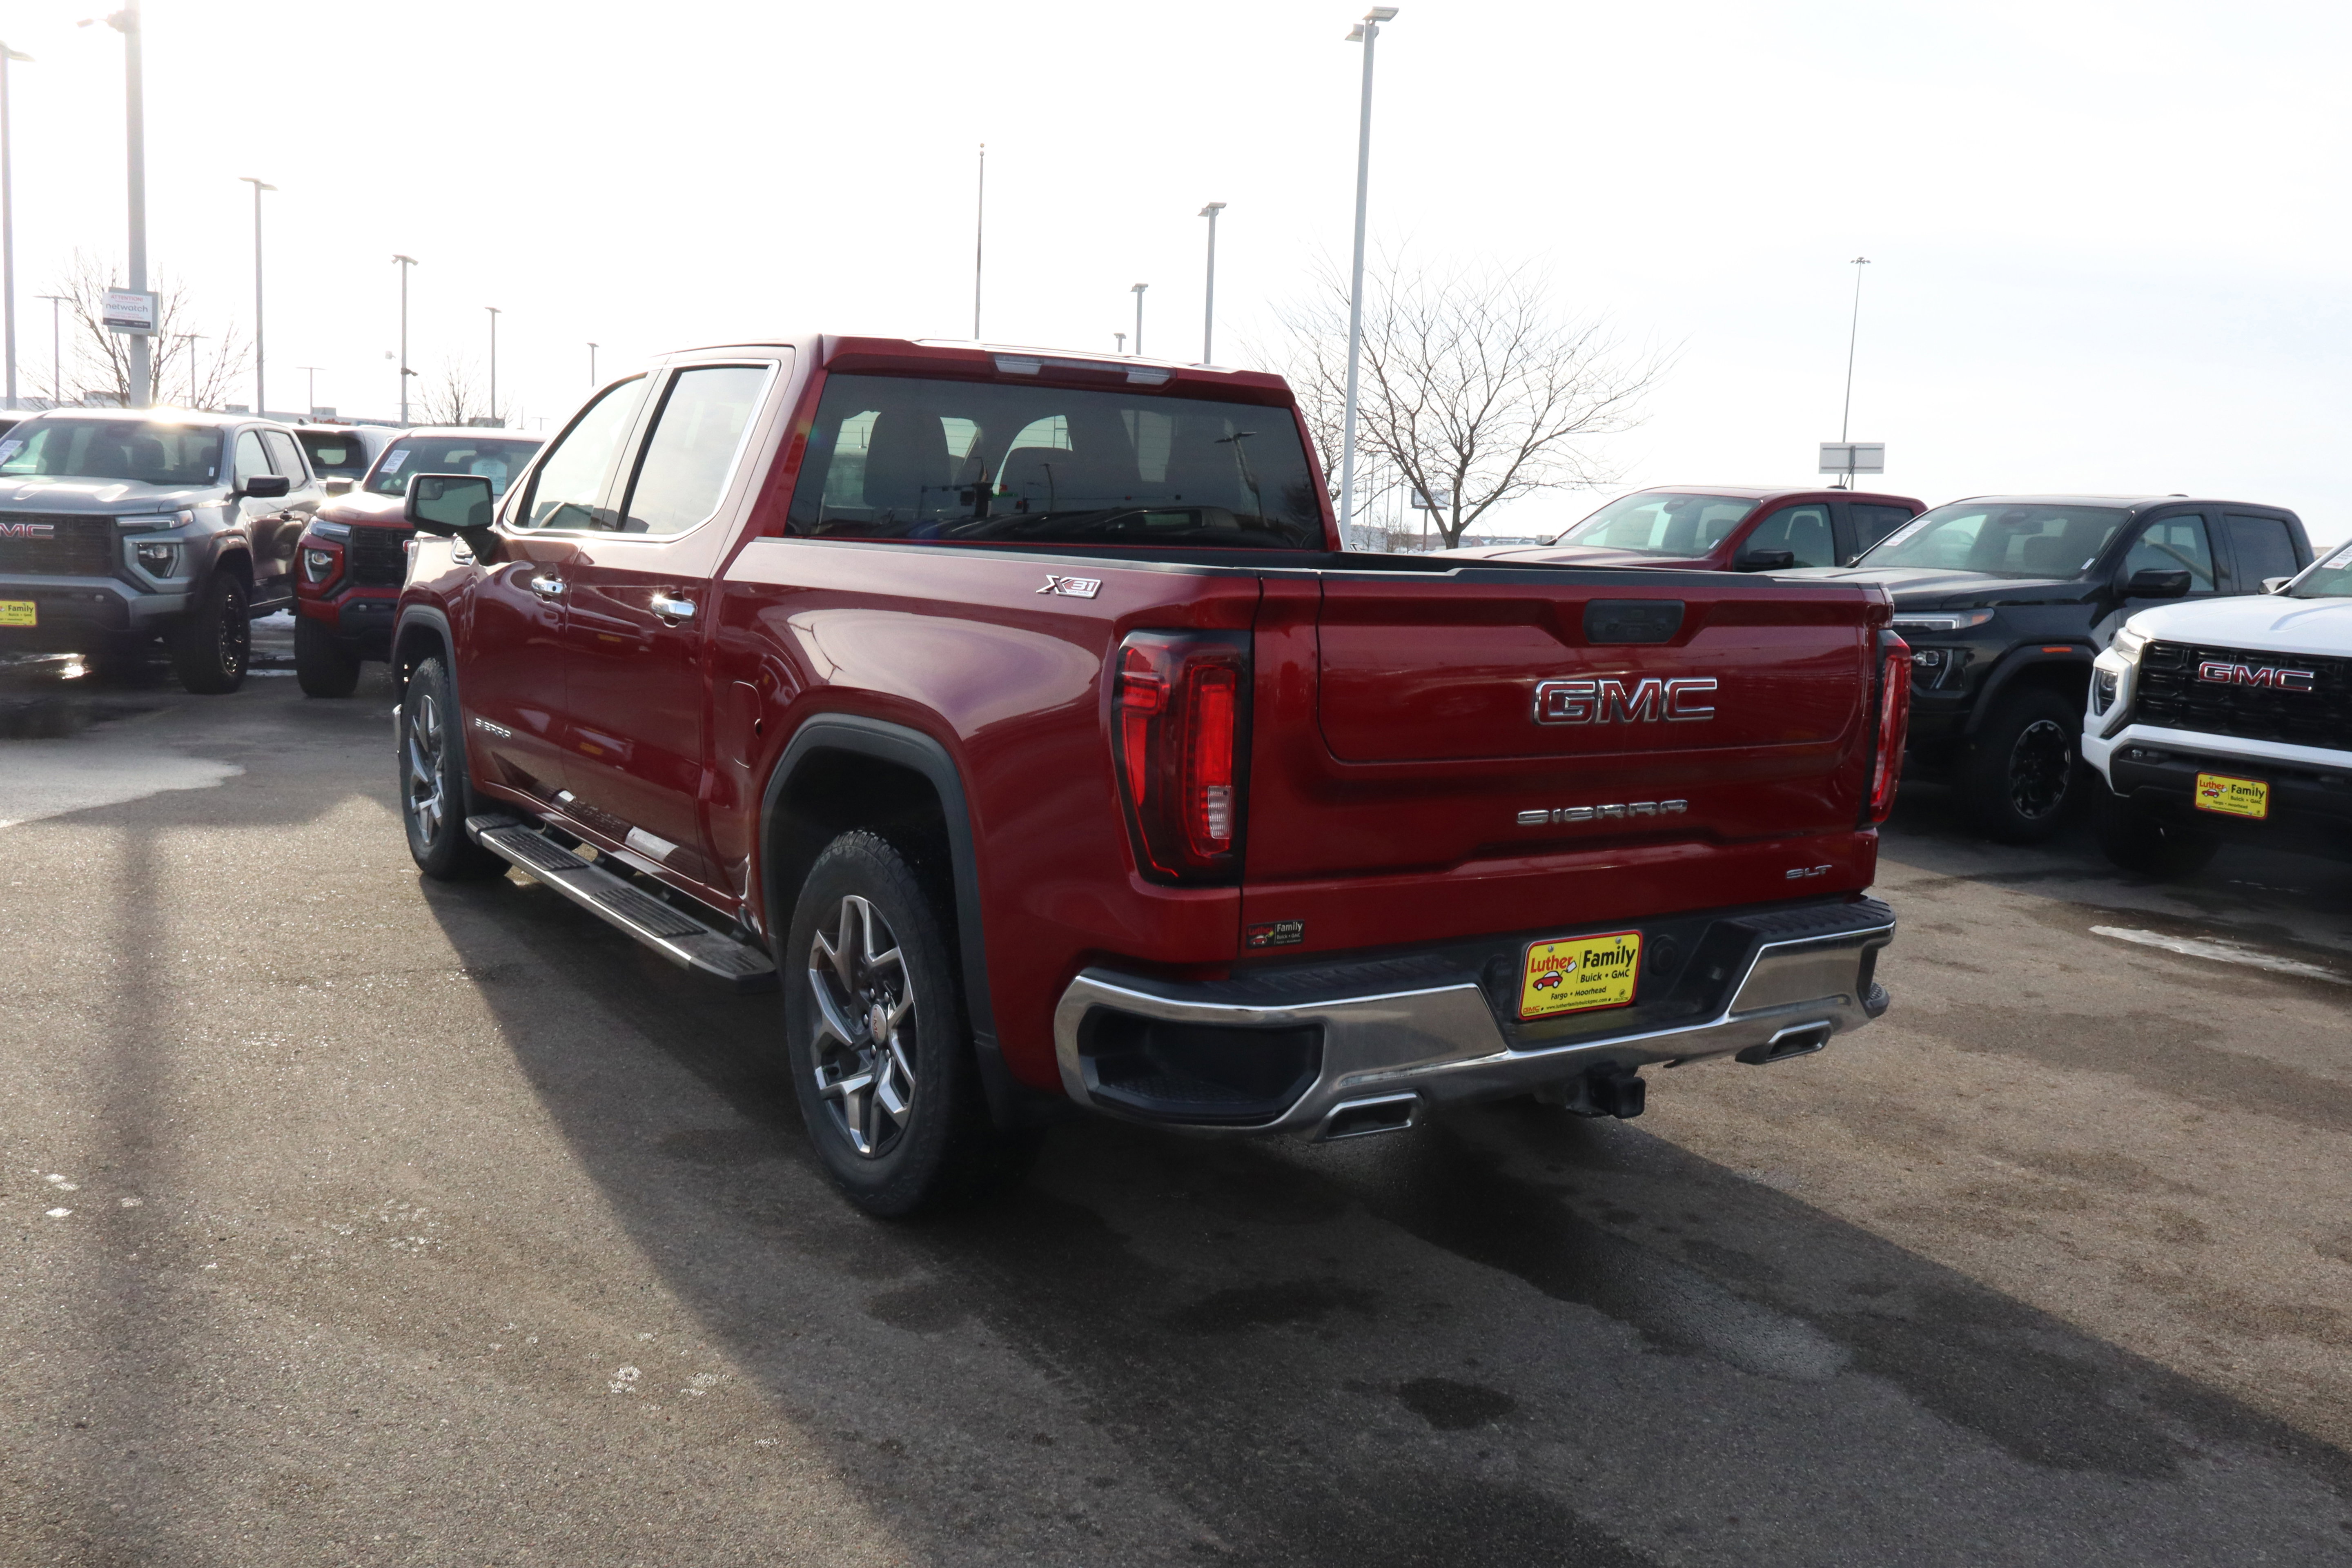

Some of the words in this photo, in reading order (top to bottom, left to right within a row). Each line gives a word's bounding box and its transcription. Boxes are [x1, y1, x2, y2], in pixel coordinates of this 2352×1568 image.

[106, 303, 148, 312] netwatch
[8, 605, 33, 613] Family
[2199, 661, 2314, 692] GMC
[1534, 677, 1717, 725] GMC
[475, 718, 512, 739] SIERRA
[2199, 780, 2225, 790] Luther
[2231, 784, 2265, 799] Family
[1517, 800, 1688, 826] SIERRA
[1786, 865, 1833, 879] SLT
[1248, 926, 1274, 935] Luther
[1277, 922, 1303, 932] Family
[1530, 955, 1574, 973] Luther
[1583, 945, 1636, 969] Family
[1580, 972, 1602, 983] Buick
[1611, 969, 1630, 978] GMC
[1575, 986, 1607, 997] Moorhead
[1546, 998, 1608, 1010] www.lutherfamilybuickgmc.com
